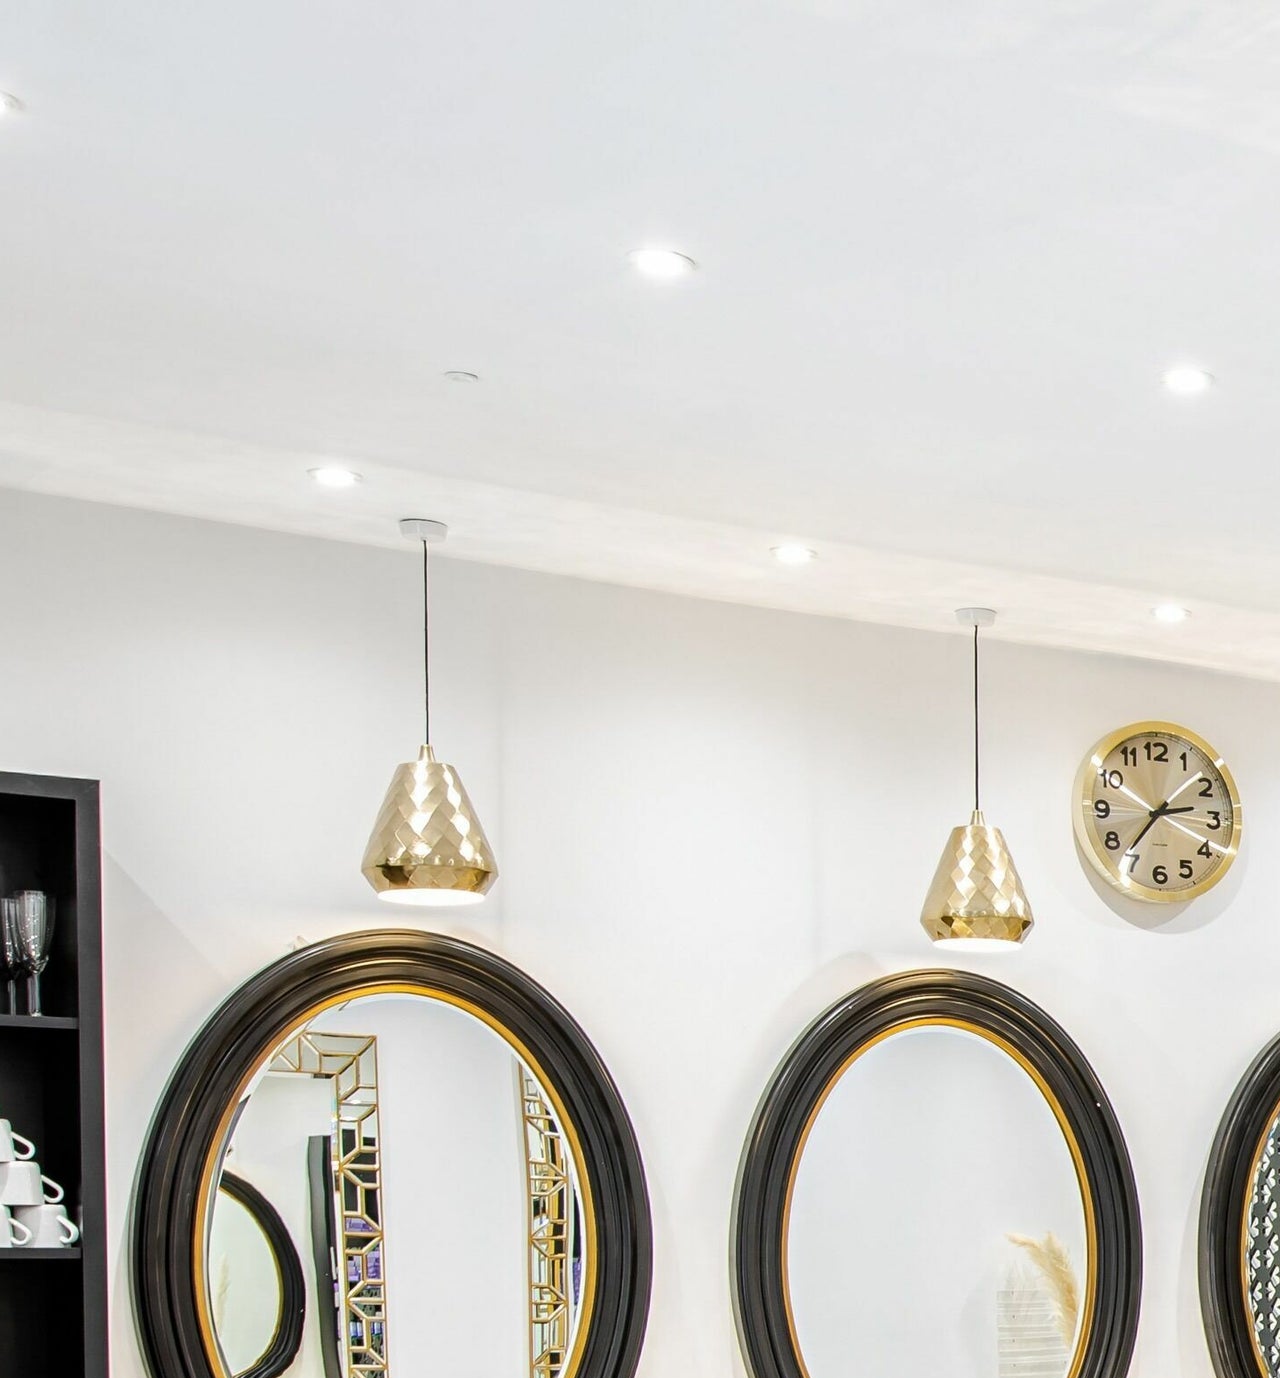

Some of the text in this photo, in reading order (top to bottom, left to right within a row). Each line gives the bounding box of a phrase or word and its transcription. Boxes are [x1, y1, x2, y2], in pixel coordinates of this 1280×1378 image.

[1120, 746, 1137, 767] 11
[1143, 741, 1169, 763] 12
[1179, 752, 1188, 771] 1
[1100, 769, 1123, 789] 10
[1198, 777, 1213, 798] 2
[1094, 799, 1110, 819] 9
[1206, 811, 1221, 830] 3
[1104, 831, 1120, 850] 8
[1197, 840, 1212, 859] 4
[1125, 853, 1140, 873] 7
[1179, 860, 1193, 879] 5
[1152, 865, 1168, 885] 6
